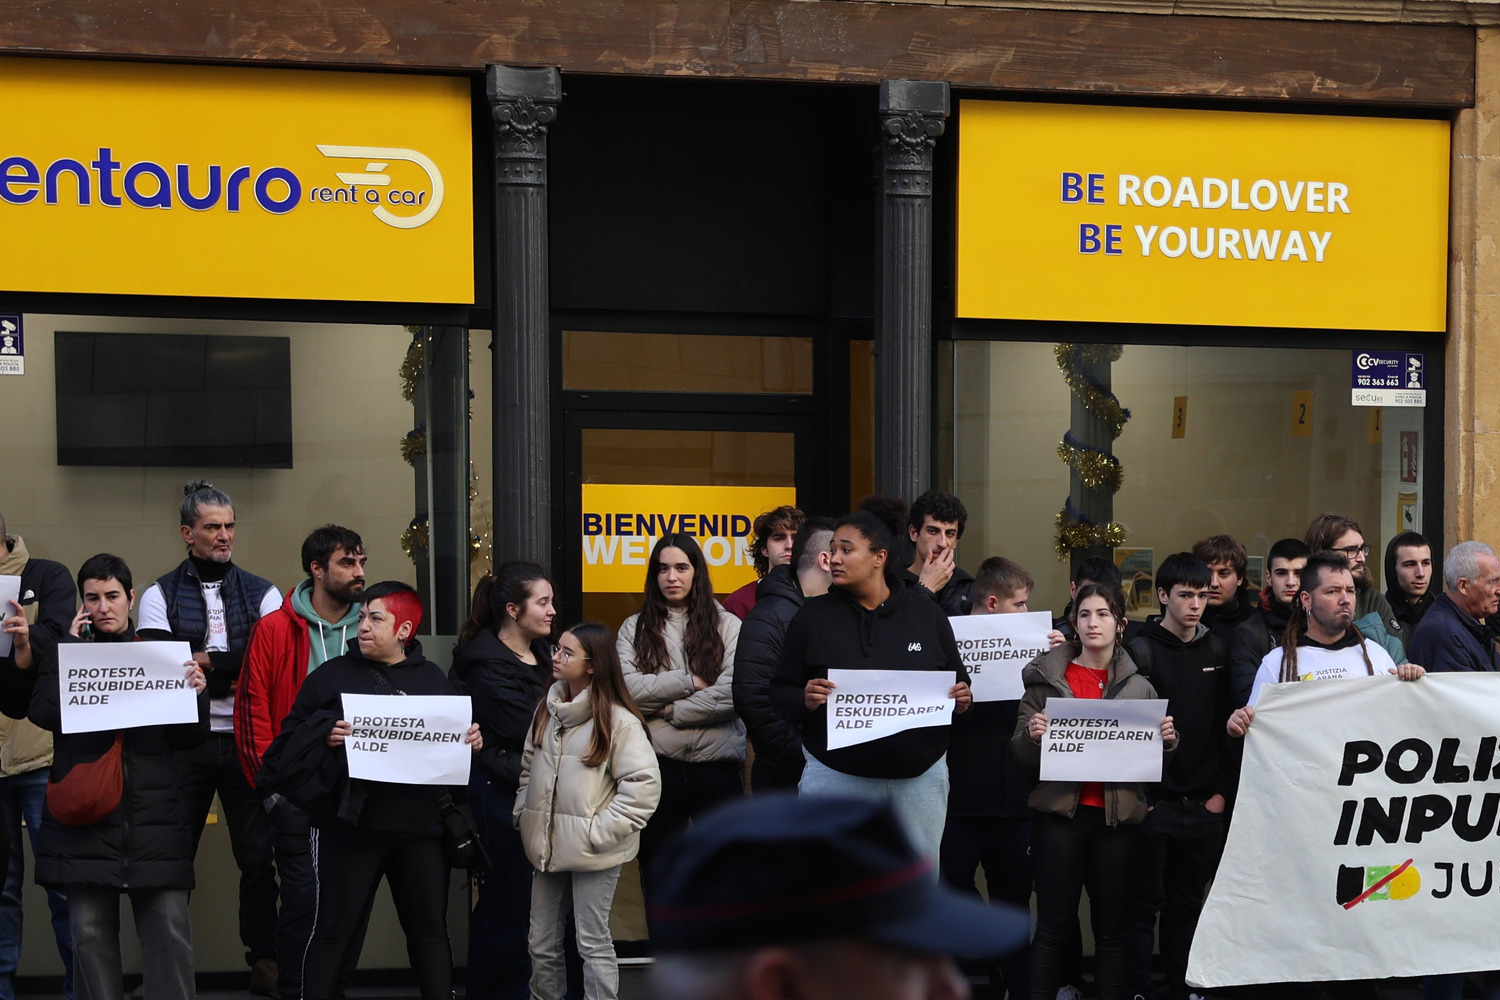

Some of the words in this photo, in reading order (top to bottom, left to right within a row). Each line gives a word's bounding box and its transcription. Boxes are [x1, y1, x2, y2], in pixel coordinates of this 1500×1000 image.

[0, 147, 302, 214] entauro
[310, 185, 359, 203] rent
[364, 187, 380, 204] a
[387, 188, 426, 206] car
[1061, 172, 1105, 205] BE
[1118, 174, 1351, 214] ROADLOVER
[1079, 223, 1123, 255] BE
[1134, 225, 1333, 262] YOURWAY
[1358, 378, 1371, 386] 902
[1372, 378, 1385, 386] 363
[1386, 378, 1399, 386] 663
[1176, 408, 1182, 427] 3
[1299, 403, 1306, 424] 2
[583, 513, 756, 537] BIENVENID
[957, 638, 1012, 650] ROTESTA
[960, 648, 1045, 662] KUBIDEAREN
[68, 667, 146, 679] PROTESTA
[965, 664, 982, 674] DE
[68, 680, 185, 692] ESKUBIDEAREN
[68, 695, 110, 706] ALDE
[836, 694, 908, 704] PROTESTA
[836, 705, 945, 717] ESKUBIDEAREN
[353, 716, 425, 728] PROTESTA
[836, 720, 874, 729] ALDE
[1050, 718, 1119, 728] PROTESTA
[352, 729, 461, 743] ESKUBIDEAREN
[1050, 730, 1154, 740] ESKUBIDEAREN
[352, 741, 389, 752] ALDE
[1048, 742, 1085, 752] ALDE
